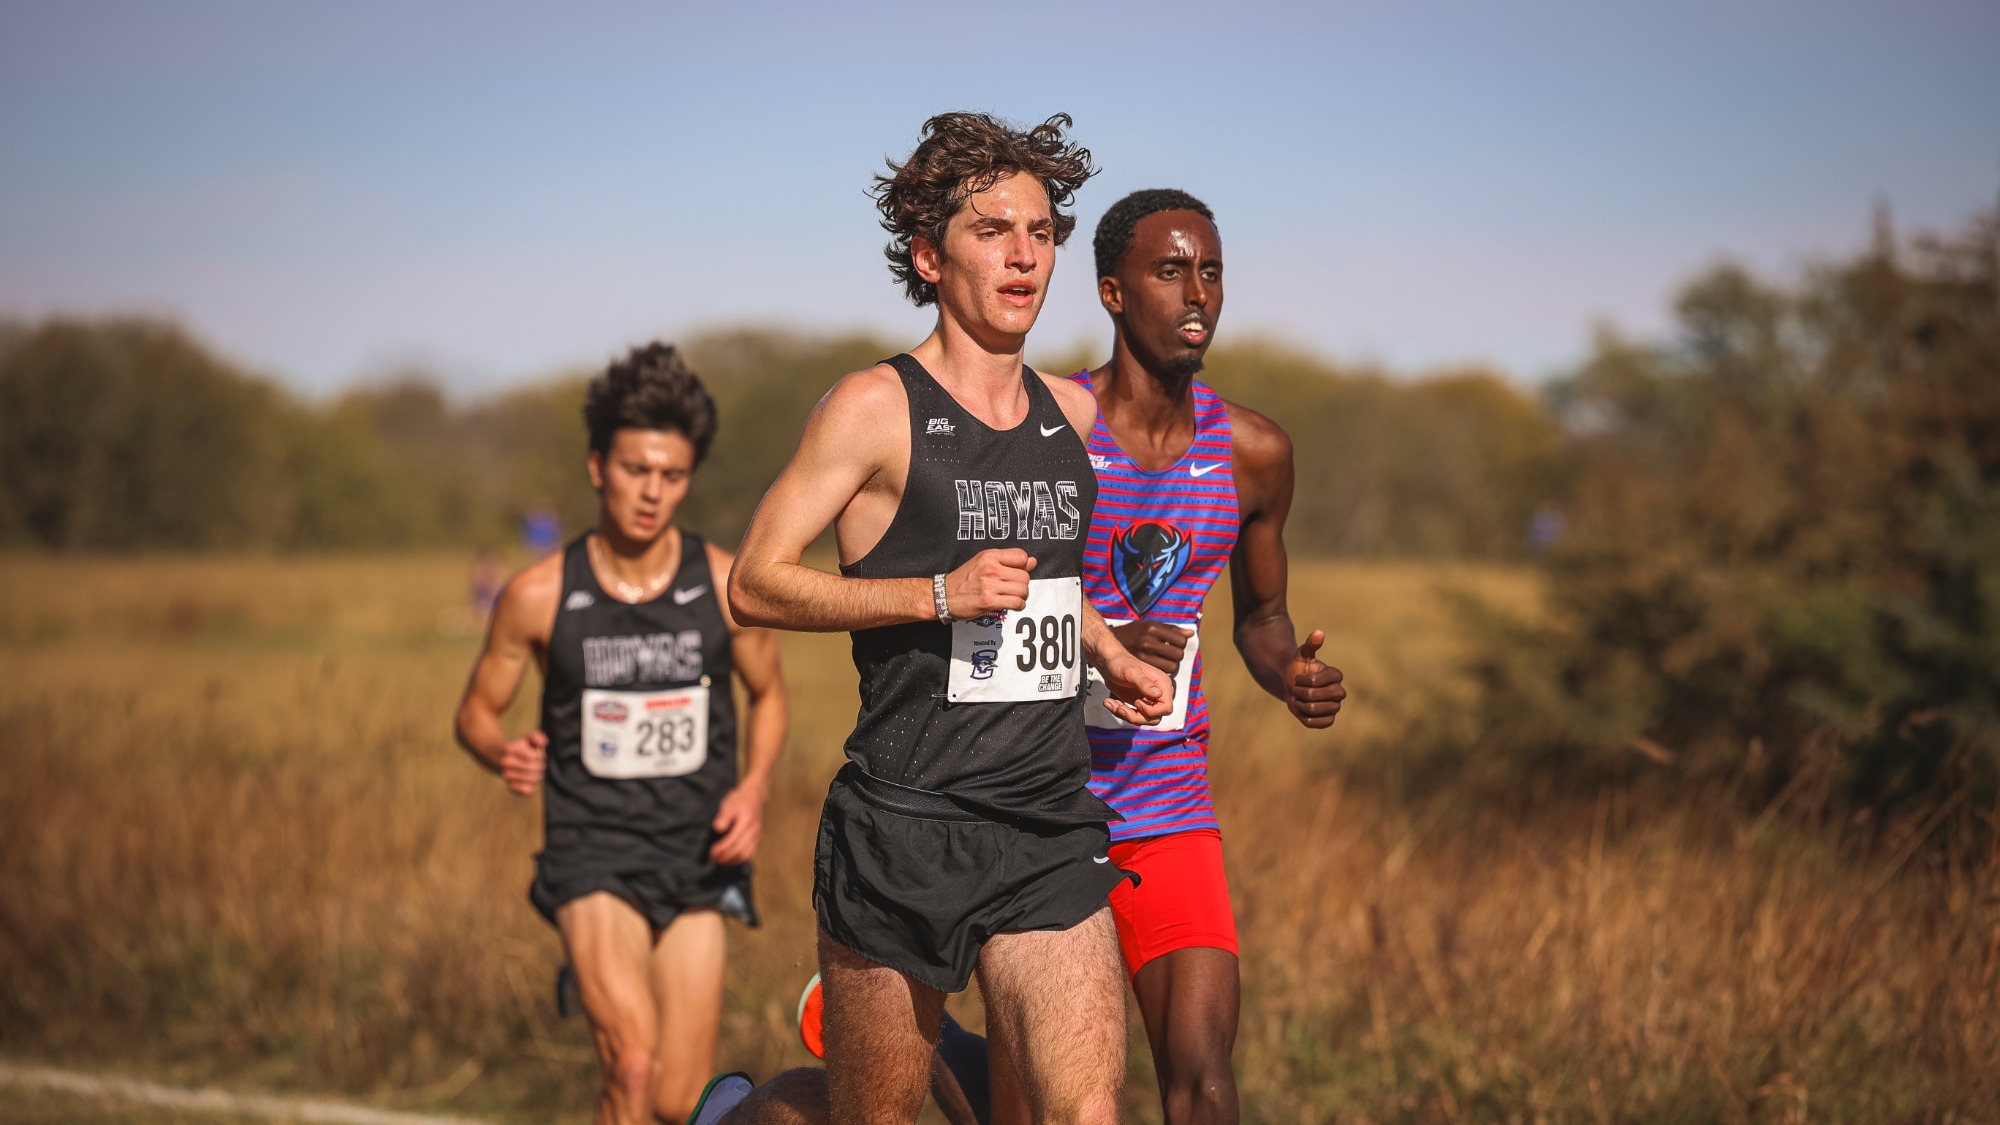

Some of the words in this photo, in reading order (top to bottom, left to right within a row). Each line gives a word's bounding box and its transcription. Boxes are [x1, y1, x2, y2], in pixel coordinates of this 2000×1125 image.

[1090, 461, 1112, 469] AST
[955, 480, 1080, 540] HOYAS
[990, 639, 997, 647] By
[1015, 614, 1075, 672] 380
[1041, 675, 1051, 684] BE
[1050, 674, 1062, 684] THE
[1038, 682, 1063, 692] CHANGE
[637, 716, 696, 757] 283
